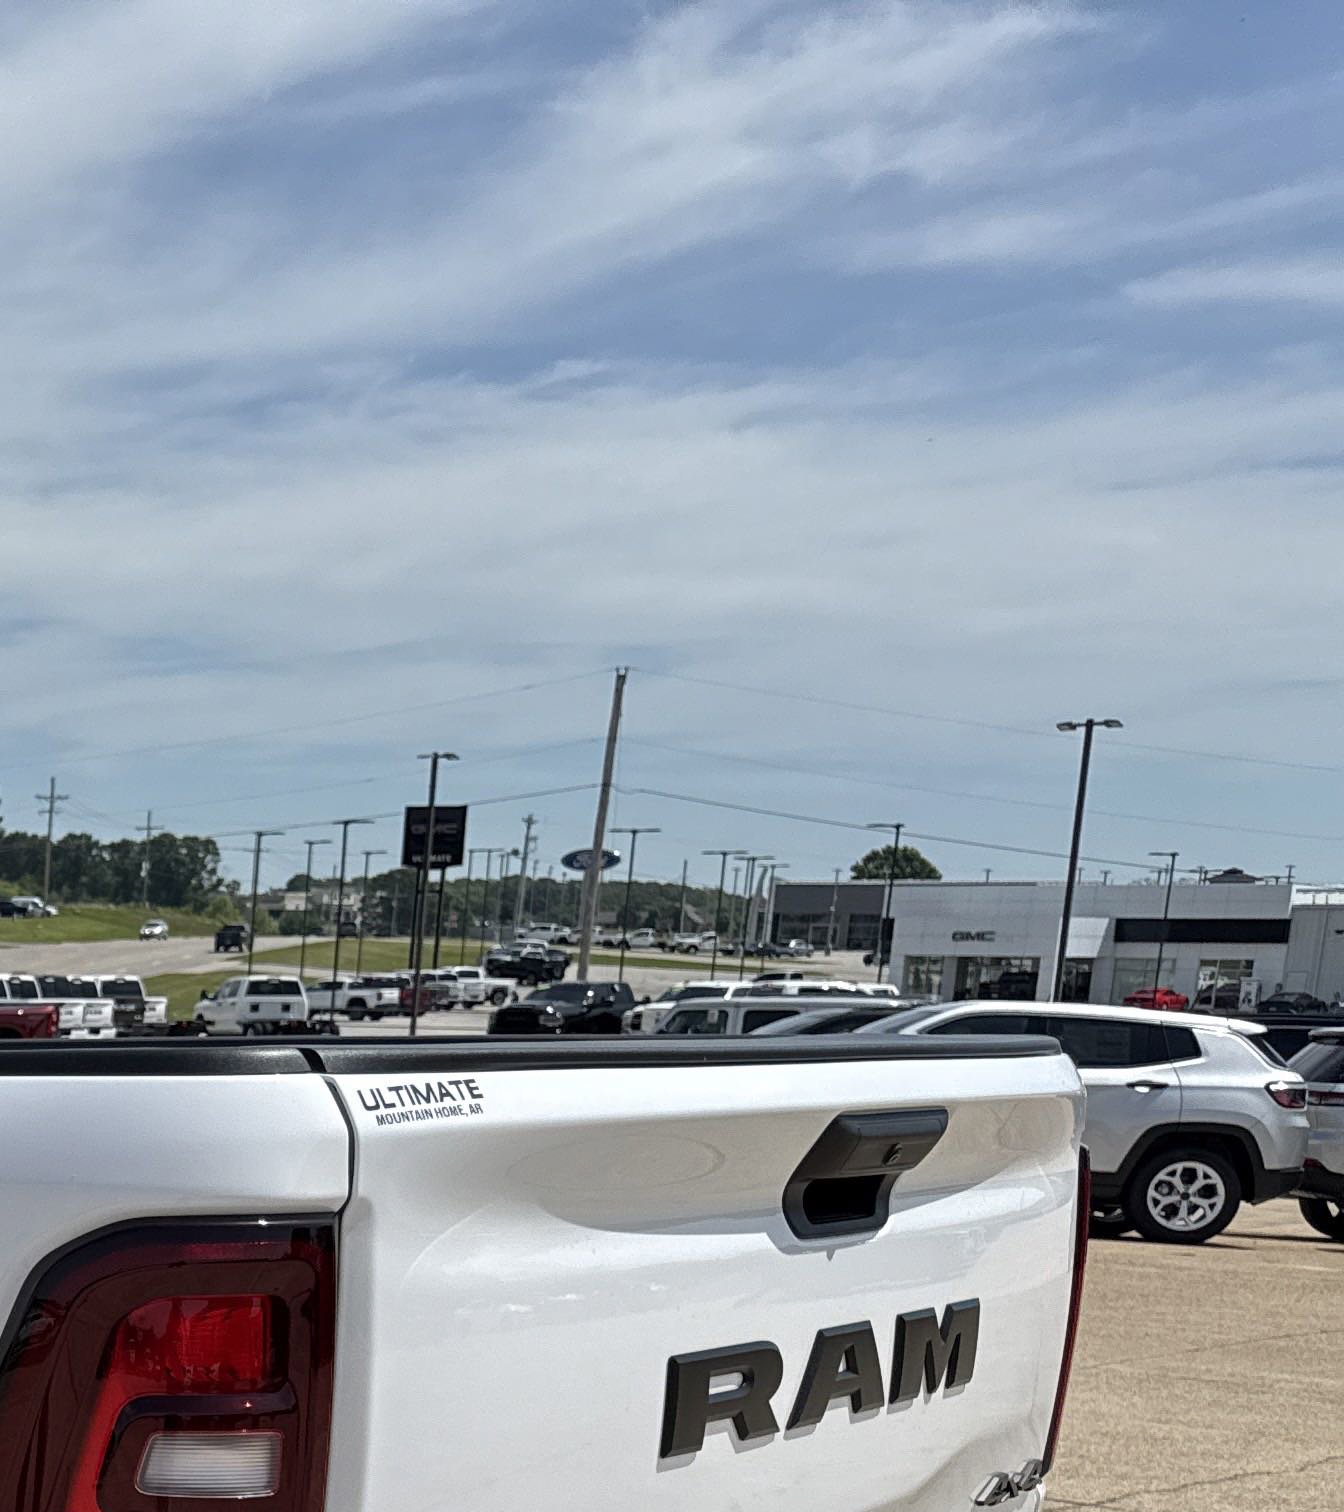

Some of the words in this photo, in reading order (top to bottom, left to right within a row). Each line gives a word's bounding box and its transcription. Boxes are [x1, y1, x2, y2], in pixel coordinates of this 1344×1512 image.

[951, 930, 996, 942] GMC
[356, 1078, 484, 1112] ULTIMATE
[375, 1107, 434, 1127] MOUNTAIN
[435, 1104, 469, 1119] HOME,
[468, 1103, 484, 1115] AR
[659, 1297, 980, 1459] RAM
